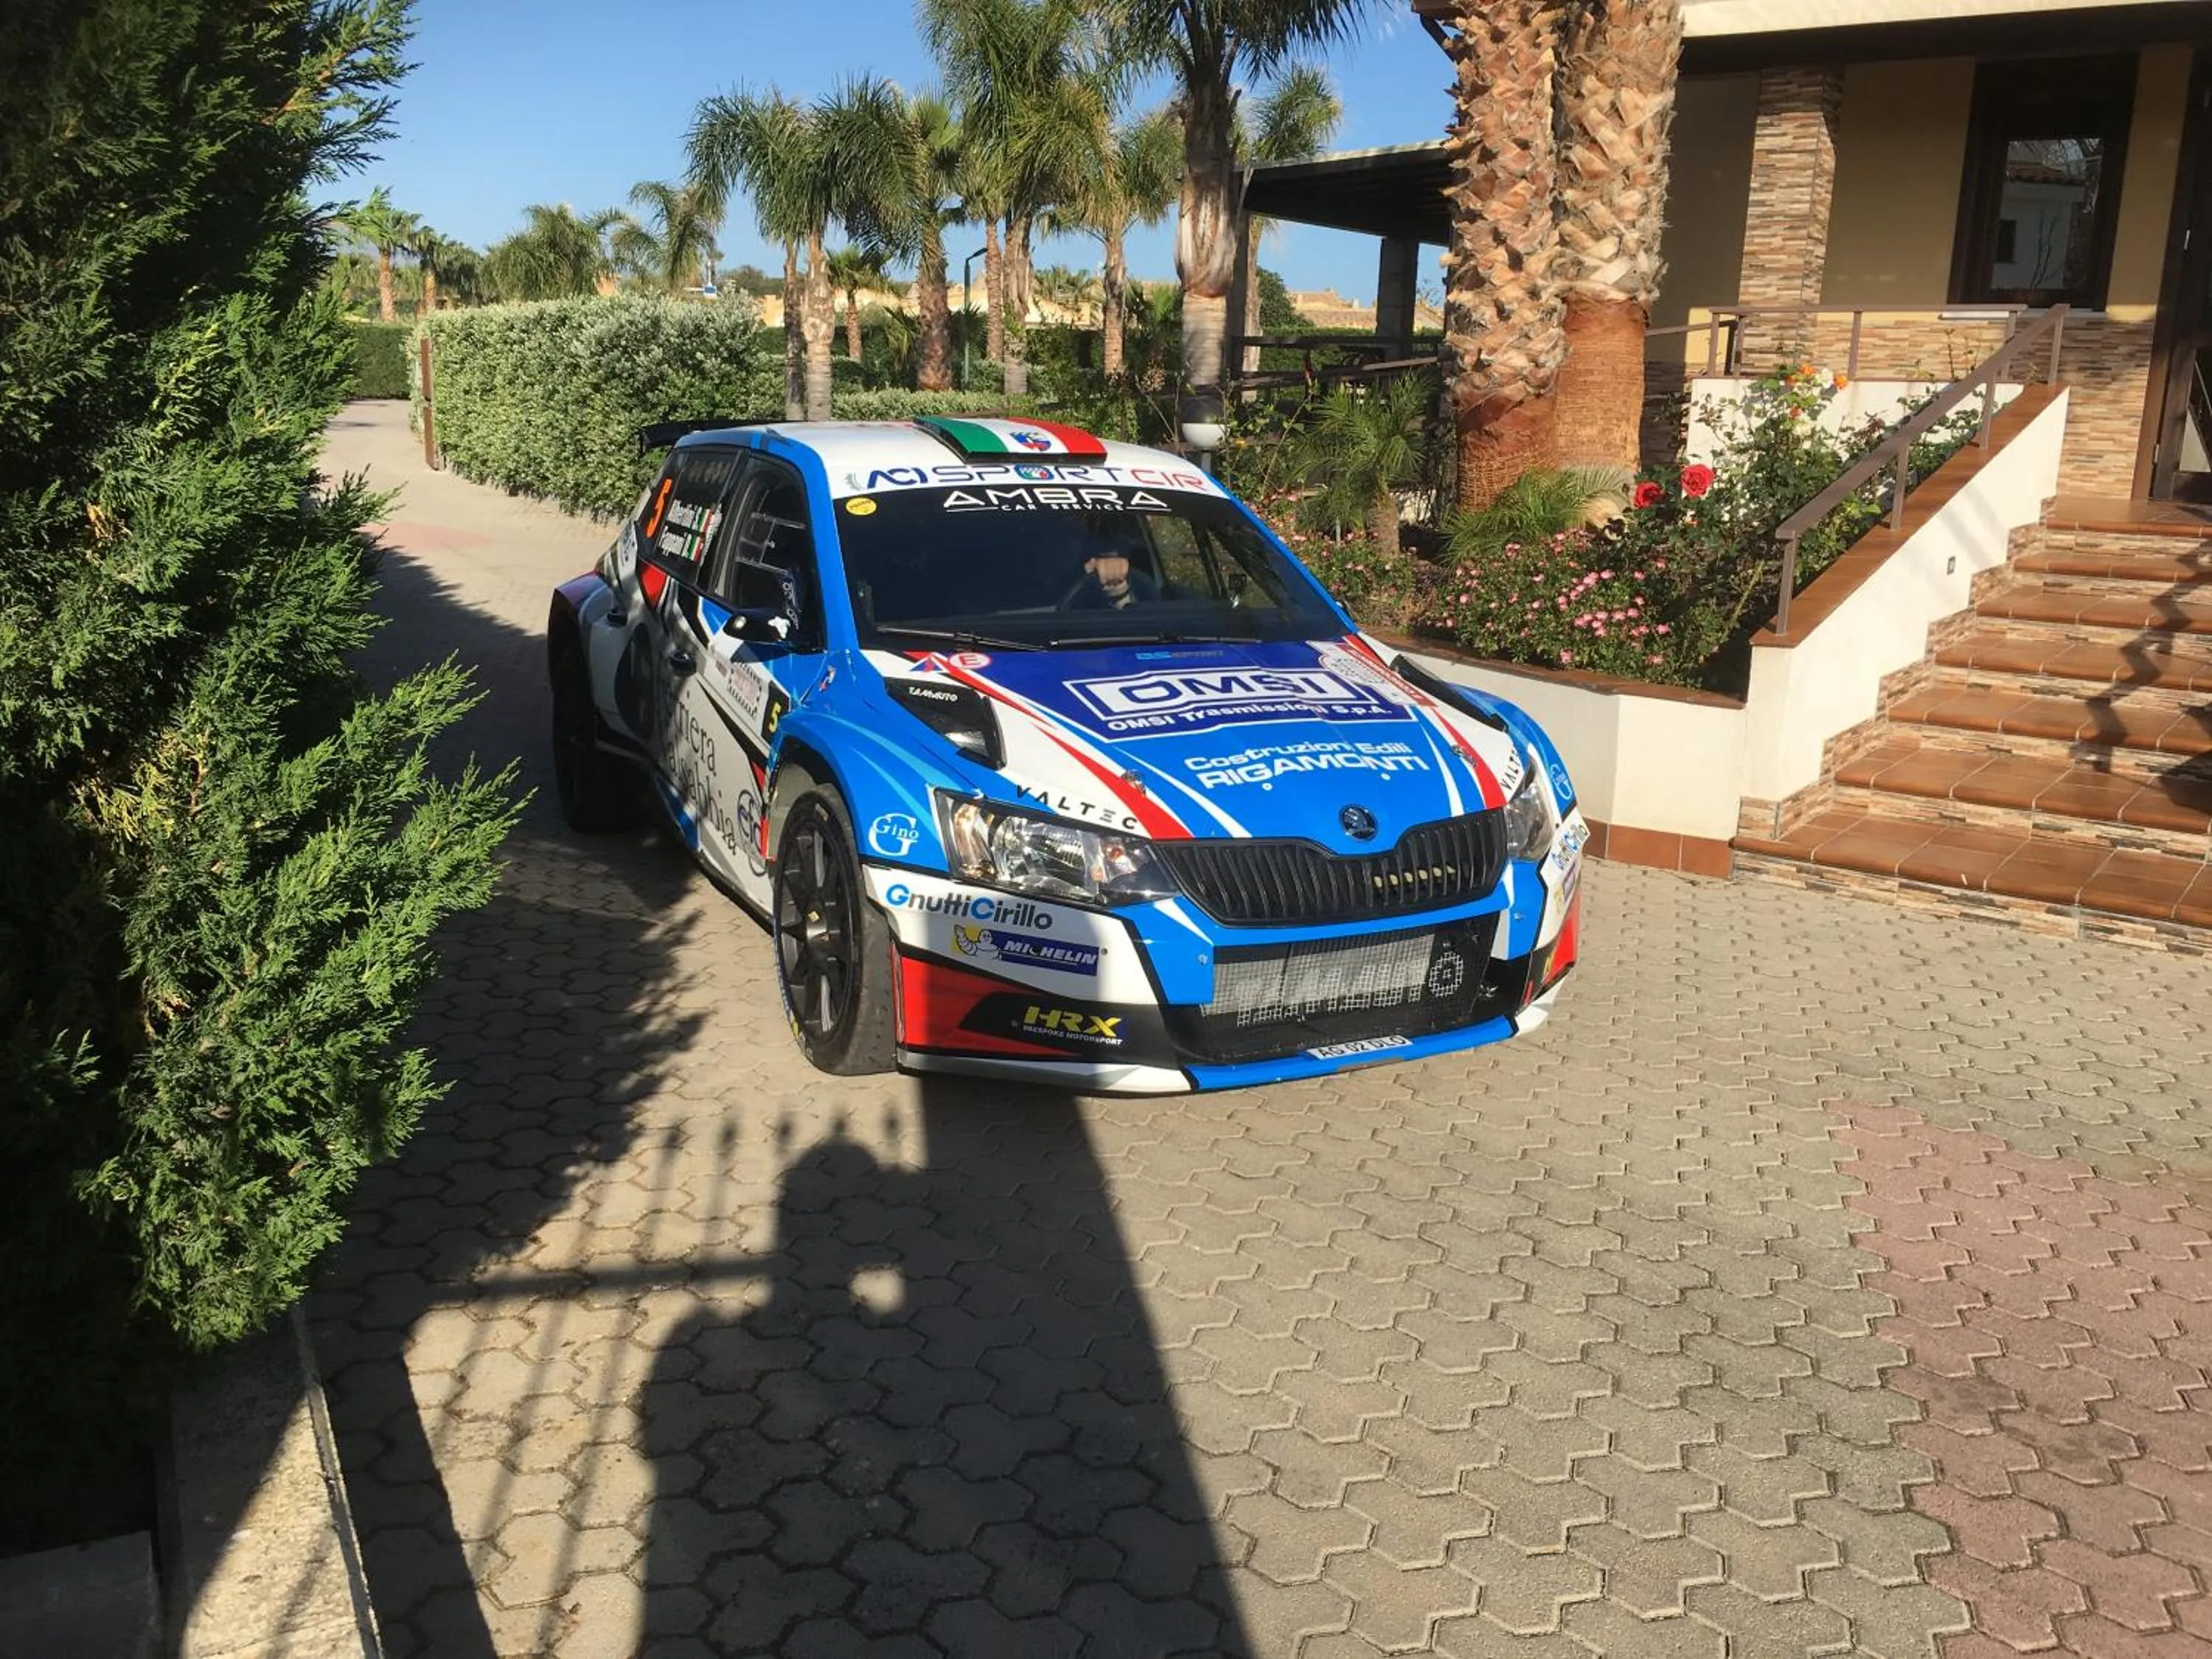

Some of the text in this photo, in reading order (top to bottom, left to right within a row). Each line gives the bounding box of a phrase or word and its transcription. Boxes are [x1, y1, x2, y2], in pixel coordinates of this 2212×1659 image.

[867, 464, 1207, 491] ACI SPORT CIR
[943, 488, 1168, 507] AMBRA
[1119, 675, 1329, 703] OMSI
[768, 702, 782, 733] 5
[1107, 716, 1175, 731] OMSI
[1180, 701, 1328, 723] Trasmissioni
[1184, 741, 1413, 771] Costruzioni Edili
[1499, 749, 1520, 790] VALT
[1195, 753, 1430, 790] RIGAMONTI
[1017, 785, 1138, 830] VALTEC
[873, 816, 919, 838] Gino
[886, 884, 1053, 930] GnuttiCirillo
[1004, 940, 1097, 964] MICHELIN
[1024, 1006, 1121, 1037] HRX
